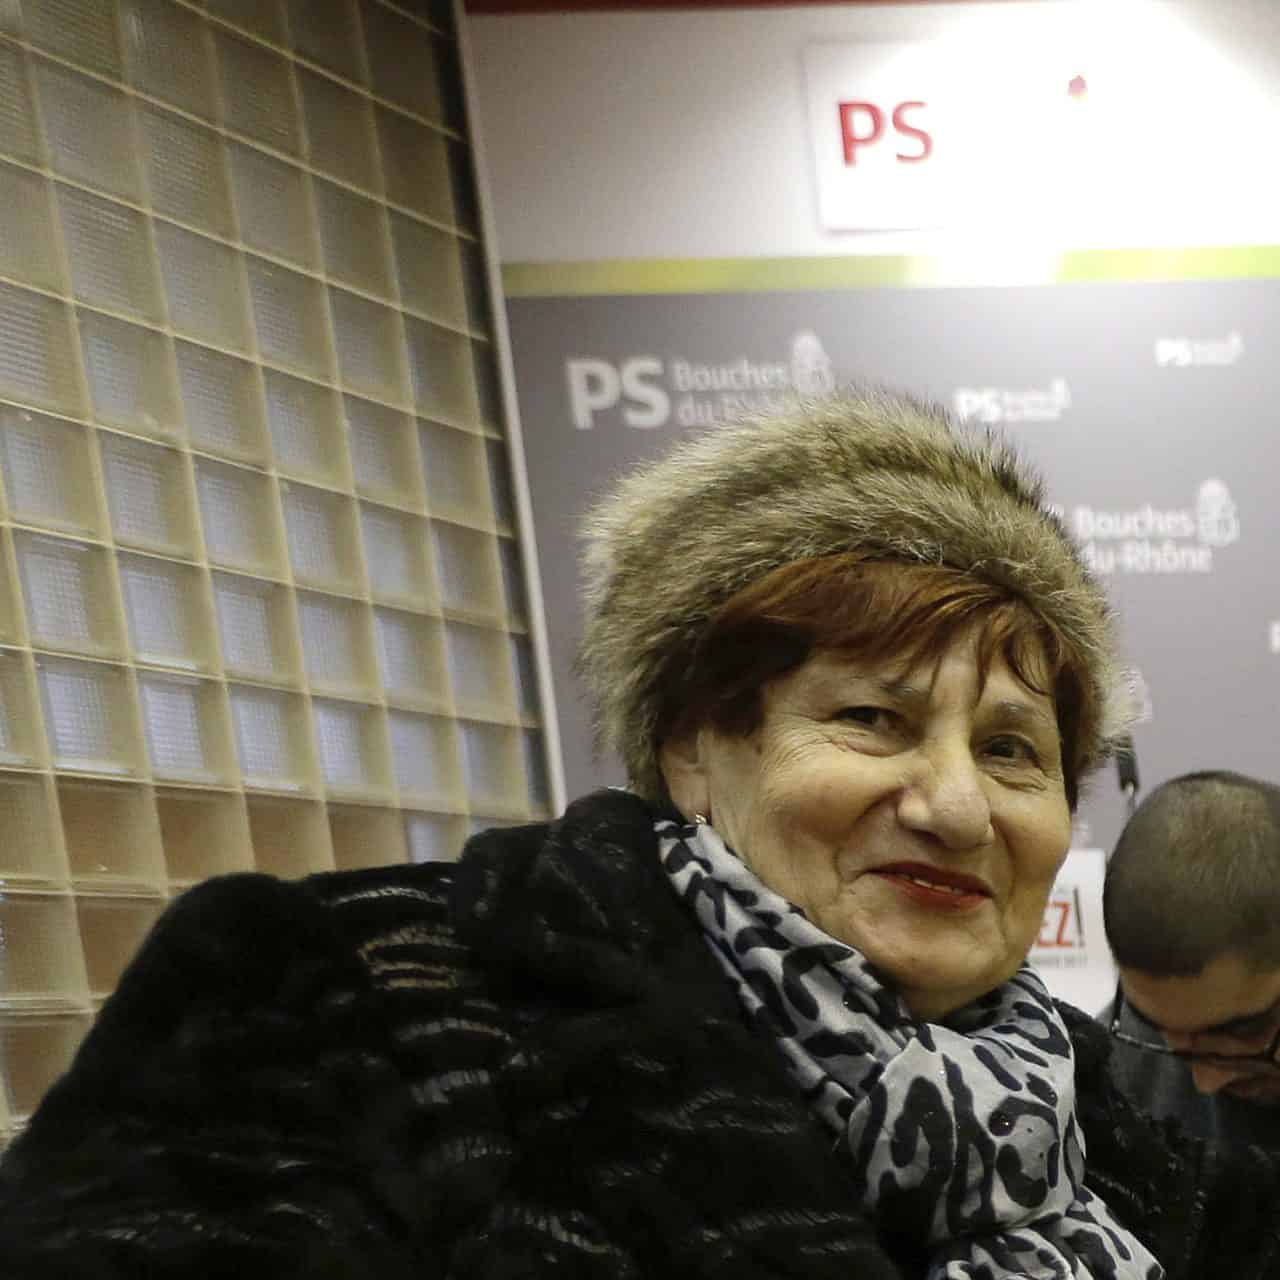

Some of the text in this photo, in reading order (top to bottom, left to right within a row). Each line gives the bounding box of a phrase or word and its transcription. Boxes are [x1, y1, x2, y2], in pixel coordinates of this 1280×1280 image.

[836, 100, 934, 166] PS
[567, 356, 671, 430] PS
[1074, 505, 1196, 540] Bouches
